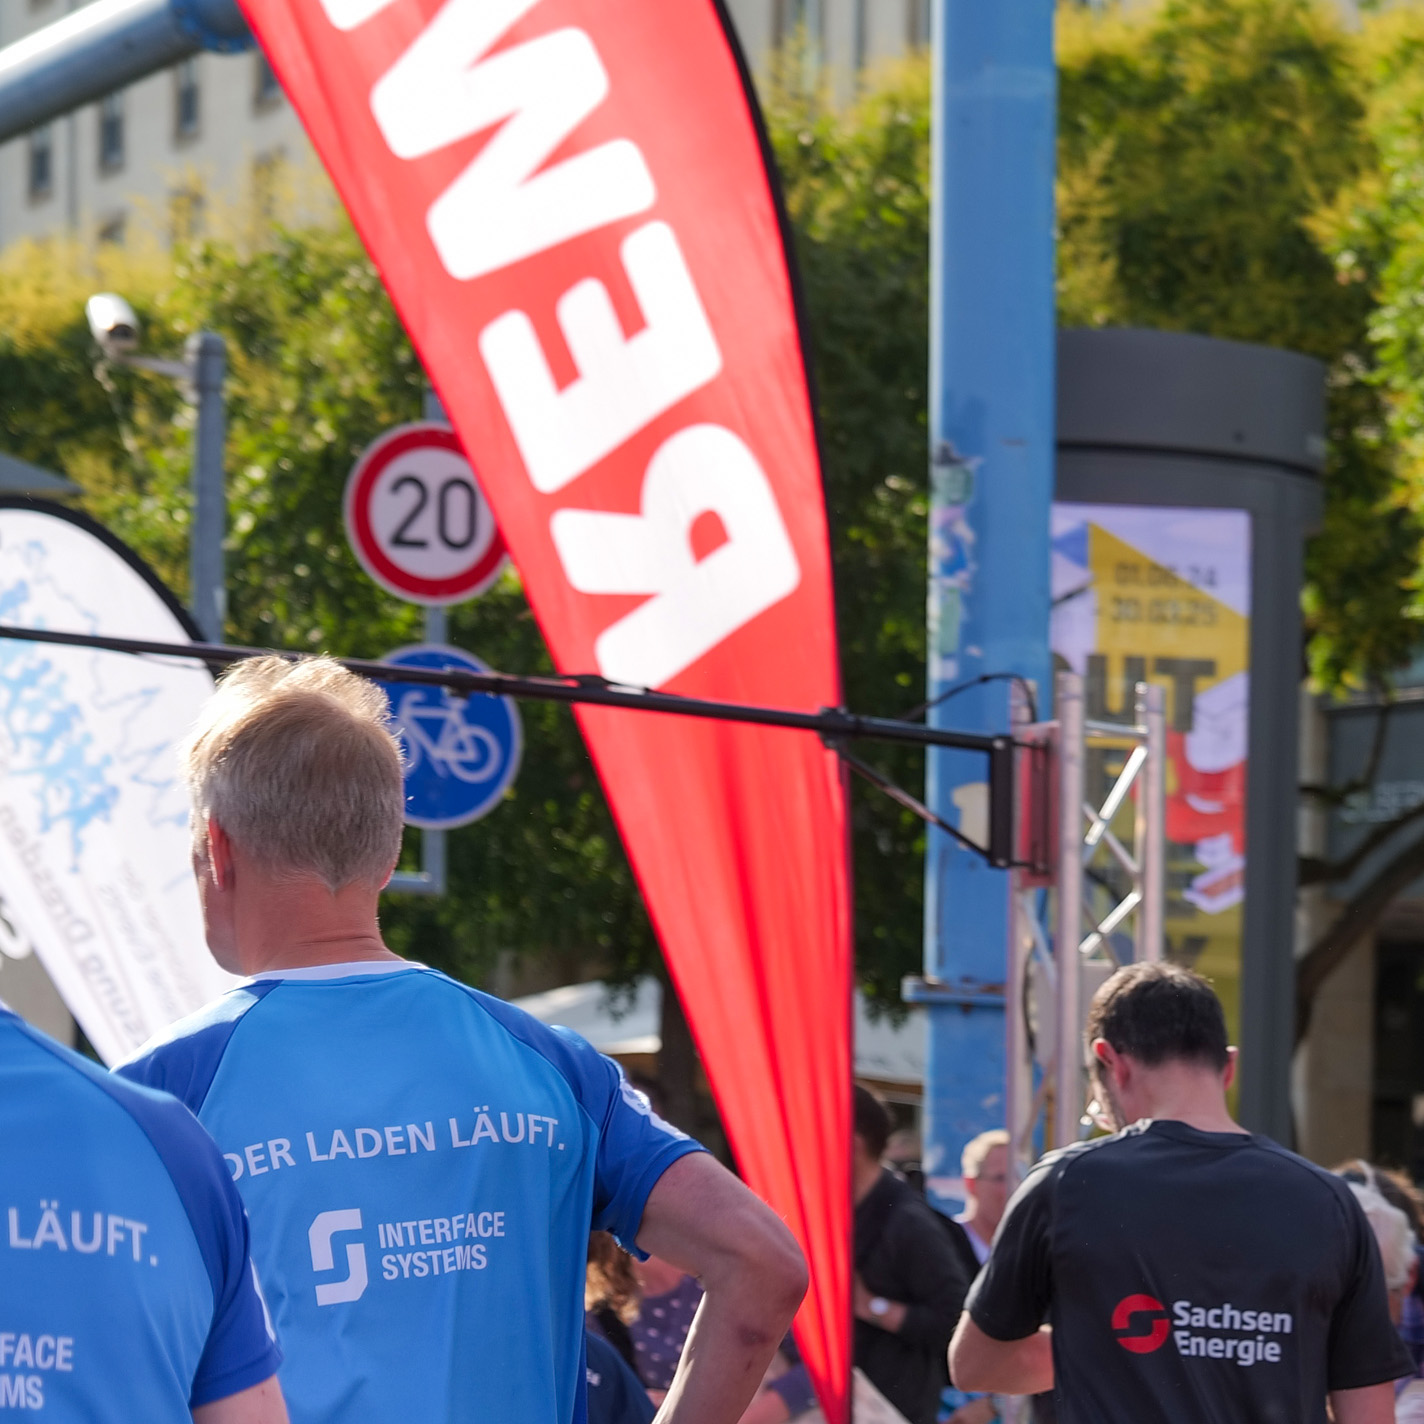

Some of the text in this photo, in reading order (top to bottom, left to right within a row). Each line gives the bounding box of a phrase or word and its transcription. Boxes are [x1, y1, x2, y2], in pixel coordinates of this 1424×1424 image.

[388, 474, 476, 551] 20
[222, 1106, 566, 1182] DER LADEN LÄUFT.
[9, 1200, 158, 1267] LÄUFT.
[378, 1212, 505, 1249] INTERFACE
[382, 1245, 487, 1280] SYSTEMS
[1172, 1300, 1293, 1334] Sachsen
[1173, 1330, 1281, 1366] Energie
